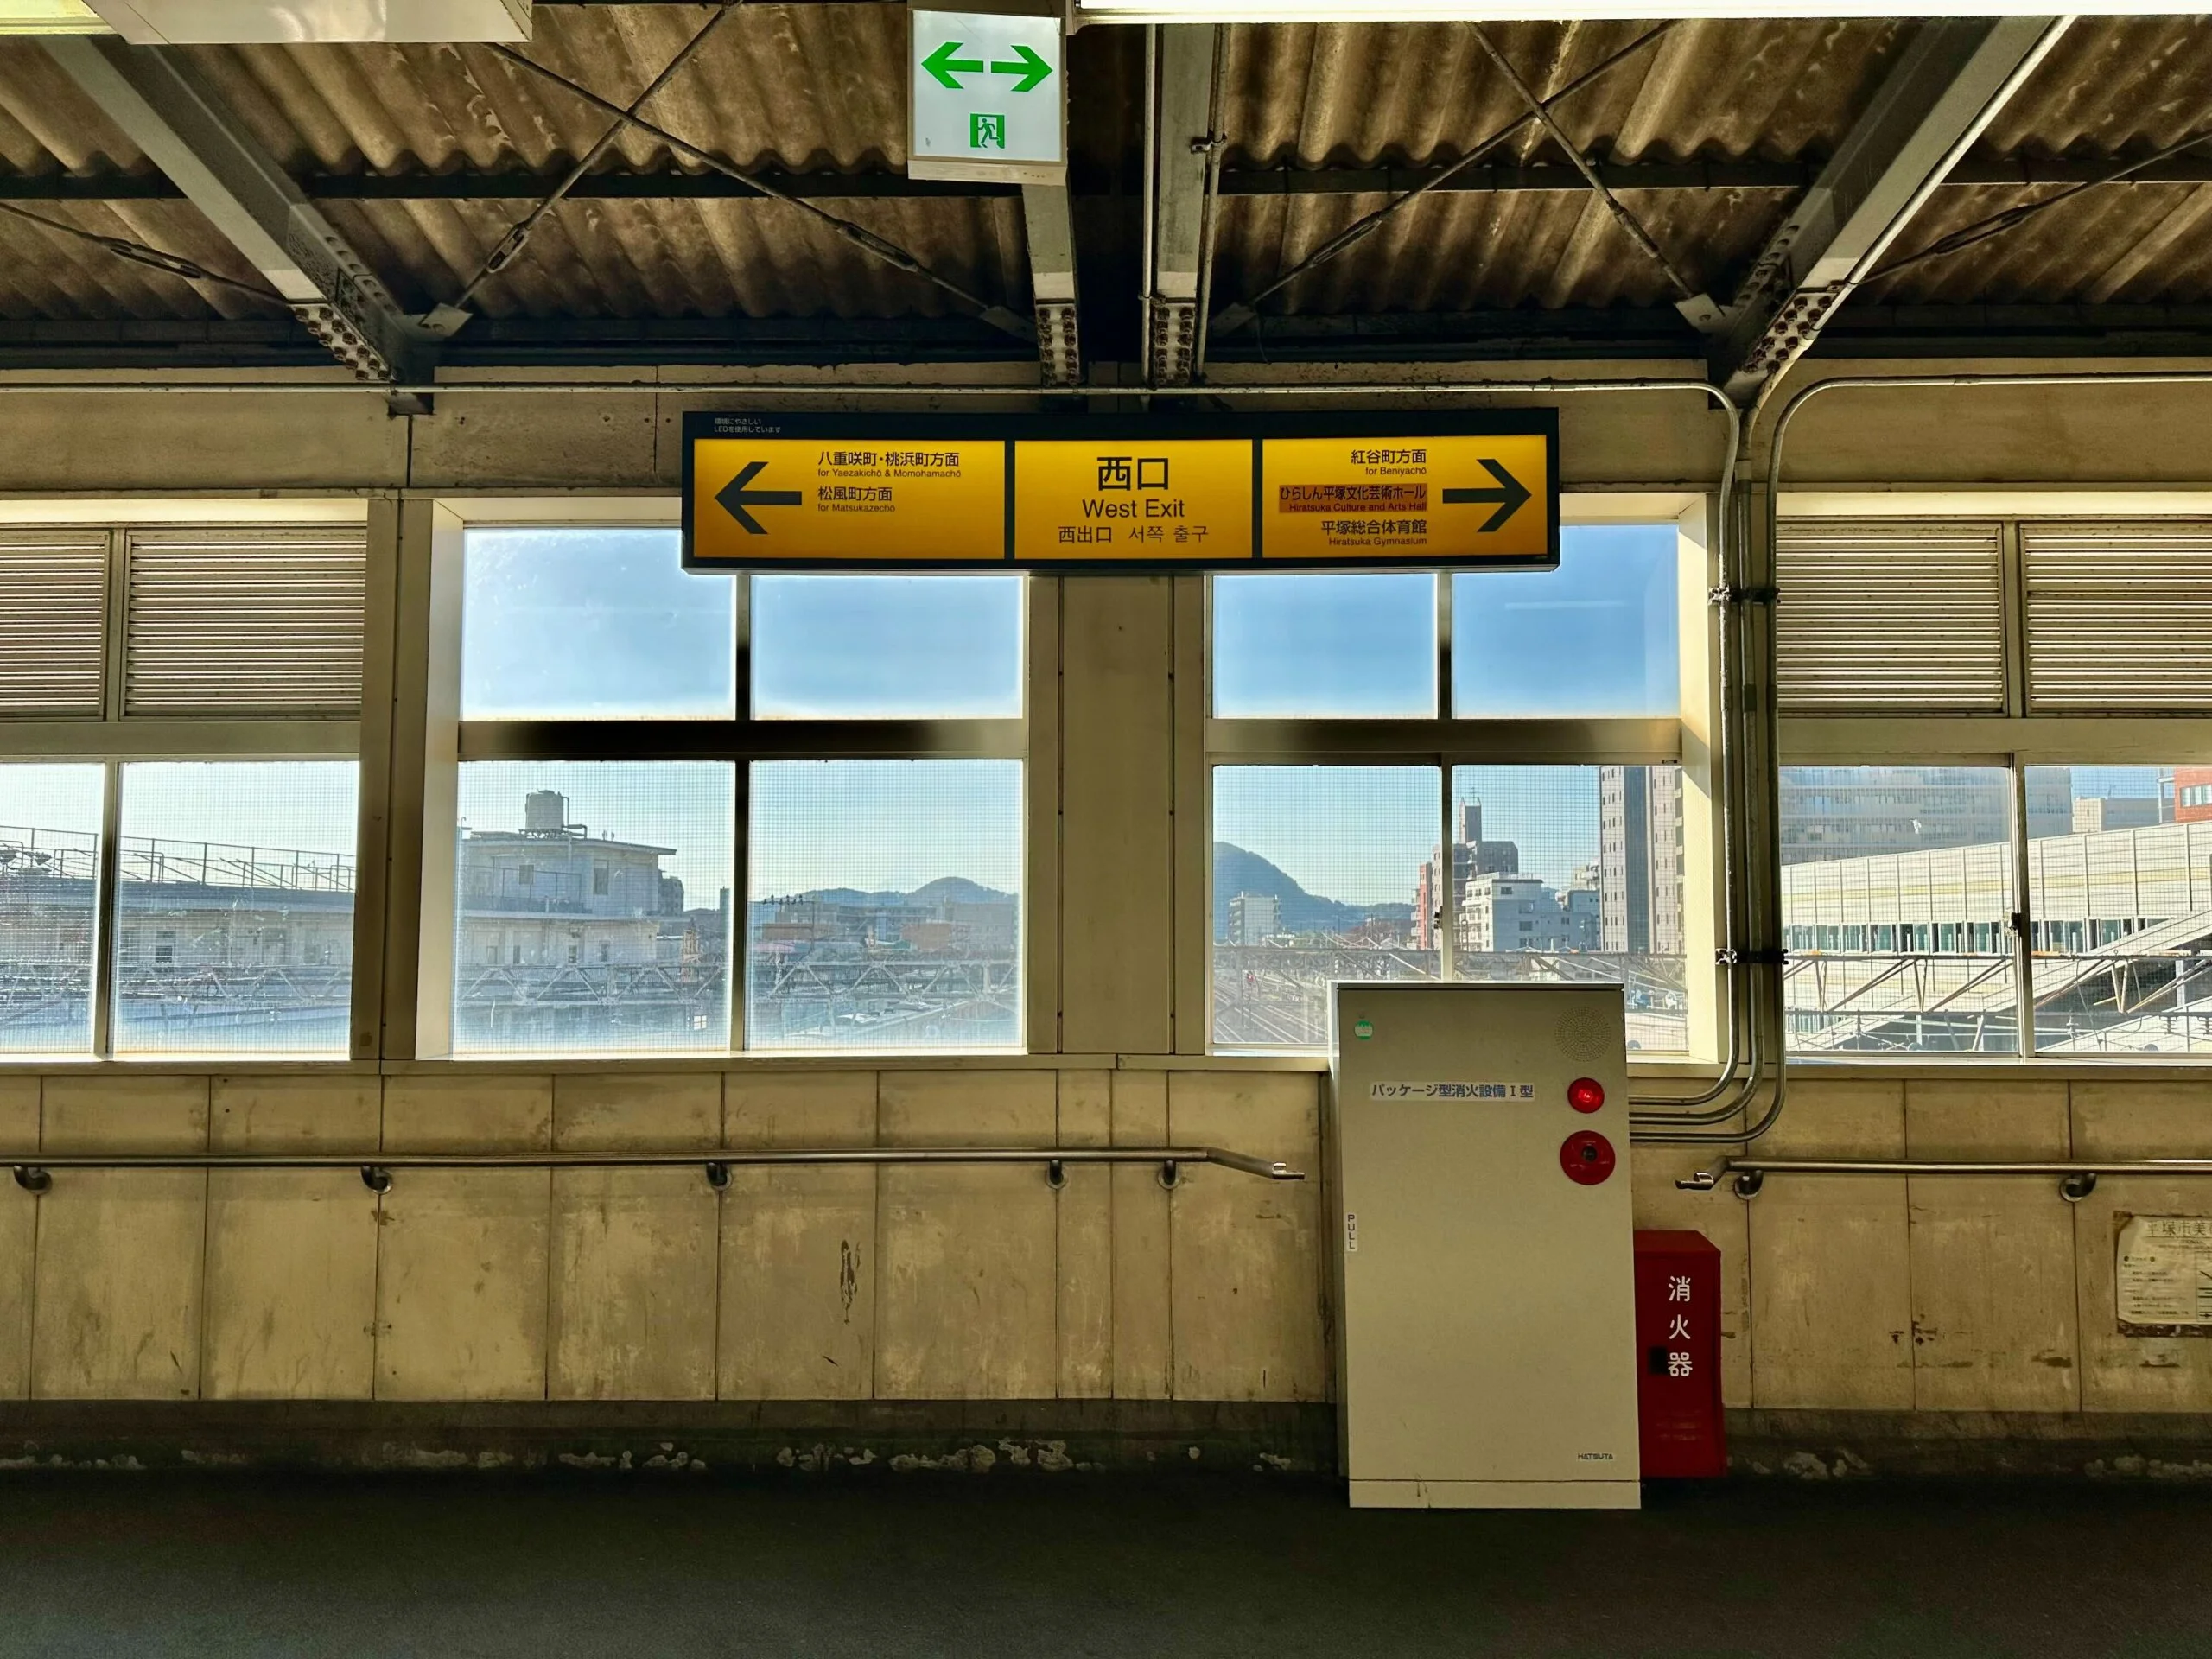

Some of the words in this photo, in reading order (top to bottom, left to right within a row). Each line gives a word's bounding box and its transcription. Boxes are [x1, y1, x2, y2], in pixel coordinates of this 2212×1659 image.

[817, 451, 960, 467] 八重咲町・桃浜町方面
[1351, 449, 1427, 465] 紅谷町方面
[817, 468, 830, 477] for
[1096, 456, 1170, 491] 西口
[1365, 467, 1377, 475] for
[817, 486, 893, 502] 松風町方面
[1280, 485, 1426, 501] ひらしん平塚文化芸術ホール
[817, 504, 830, 512] for
[1082, 499, 1138, 518] West
[1145, 499, 1185, 518] Exit
[1289, 503, 1332, 512] Hiratsuka
[1333, 503, 1366, 512] Culture
[1368, 503, 1386, 512] and
[1388, 503, 1407, 512] Arts
[1408, 502, 1427, 512] Hall
[1058, 525, 1113, 544] 西出口
[1128, 525, 1165, 543] 서쪽
[1173, 525, 1209, 543] 출구
[1320, 519, 1427, 535] 平塚総合体育館
[1329, 537, 1372, 546] Hiratsuka
[1373, 537, 1427, 547] Gymnasium
[1347, 1214, 1356, 1249] PULL
[1667, 1275, 1694, 1377] 消火器
